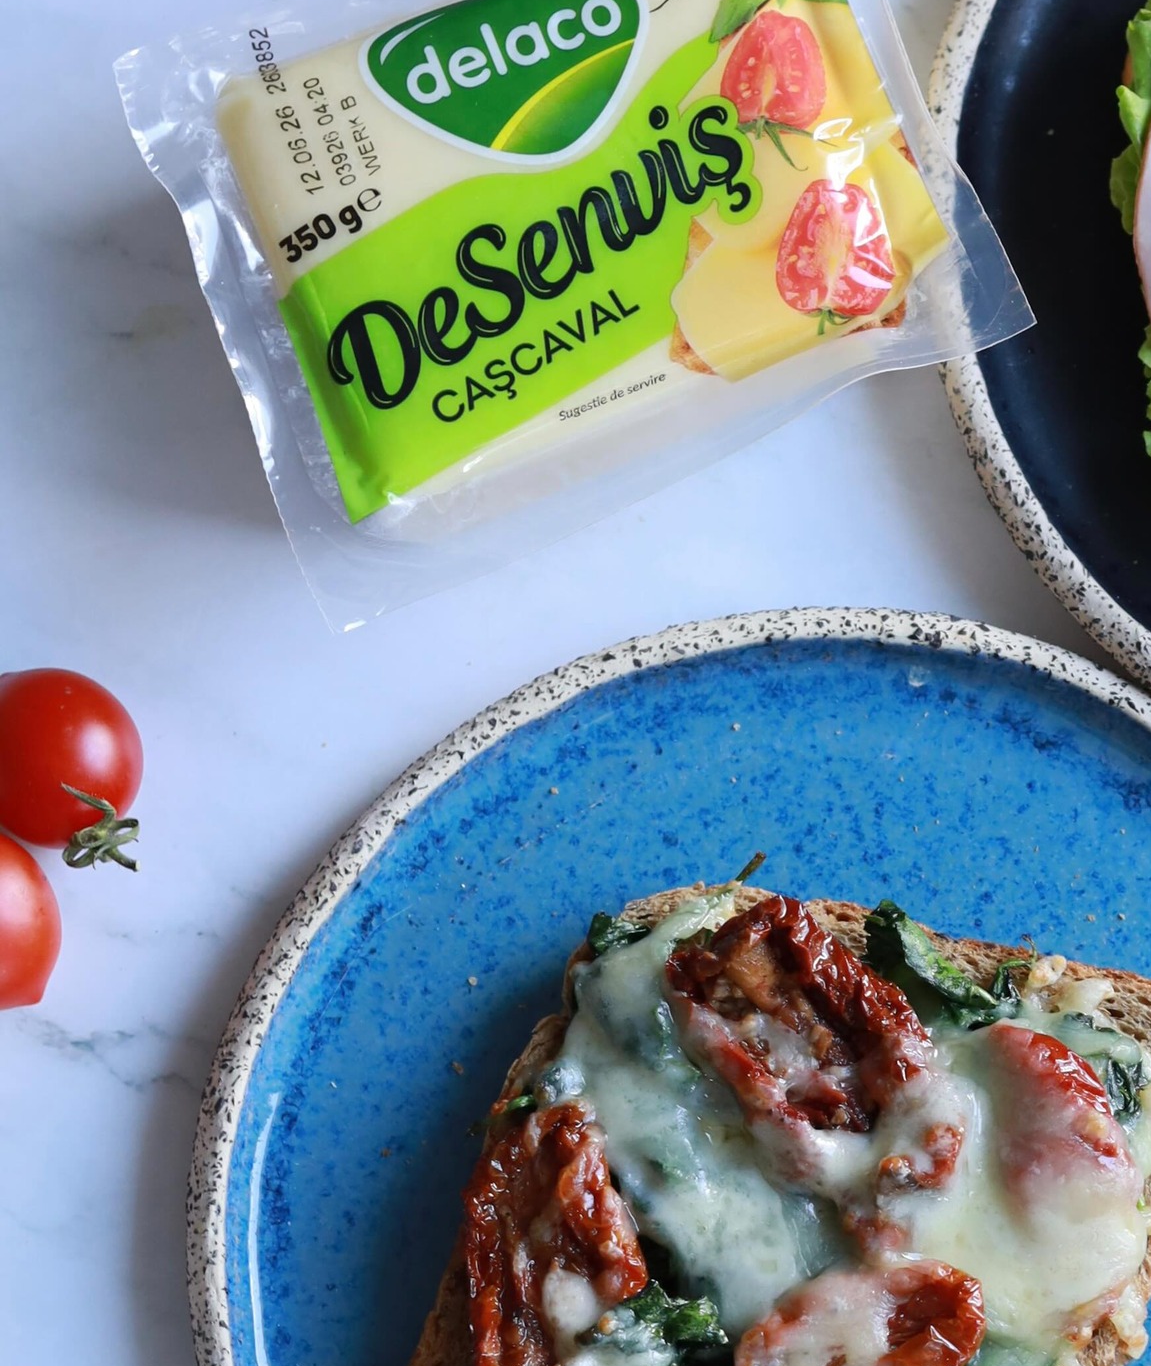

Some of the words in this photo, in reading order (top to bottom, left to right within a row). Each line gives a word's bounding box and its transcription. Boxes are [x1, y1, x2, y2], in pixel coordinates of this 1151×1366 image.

[340, 95, 357, 110] B
[275, 105, 324, 195] 12.06.26
[348, 116, 381, 176] WERK
[431, 289, 640, 422] CAŞCAVAL
[558, 396, 608, 421] Sugestie
[610, 390, 625, 401] de
[627, 374, 666, 394] servire
